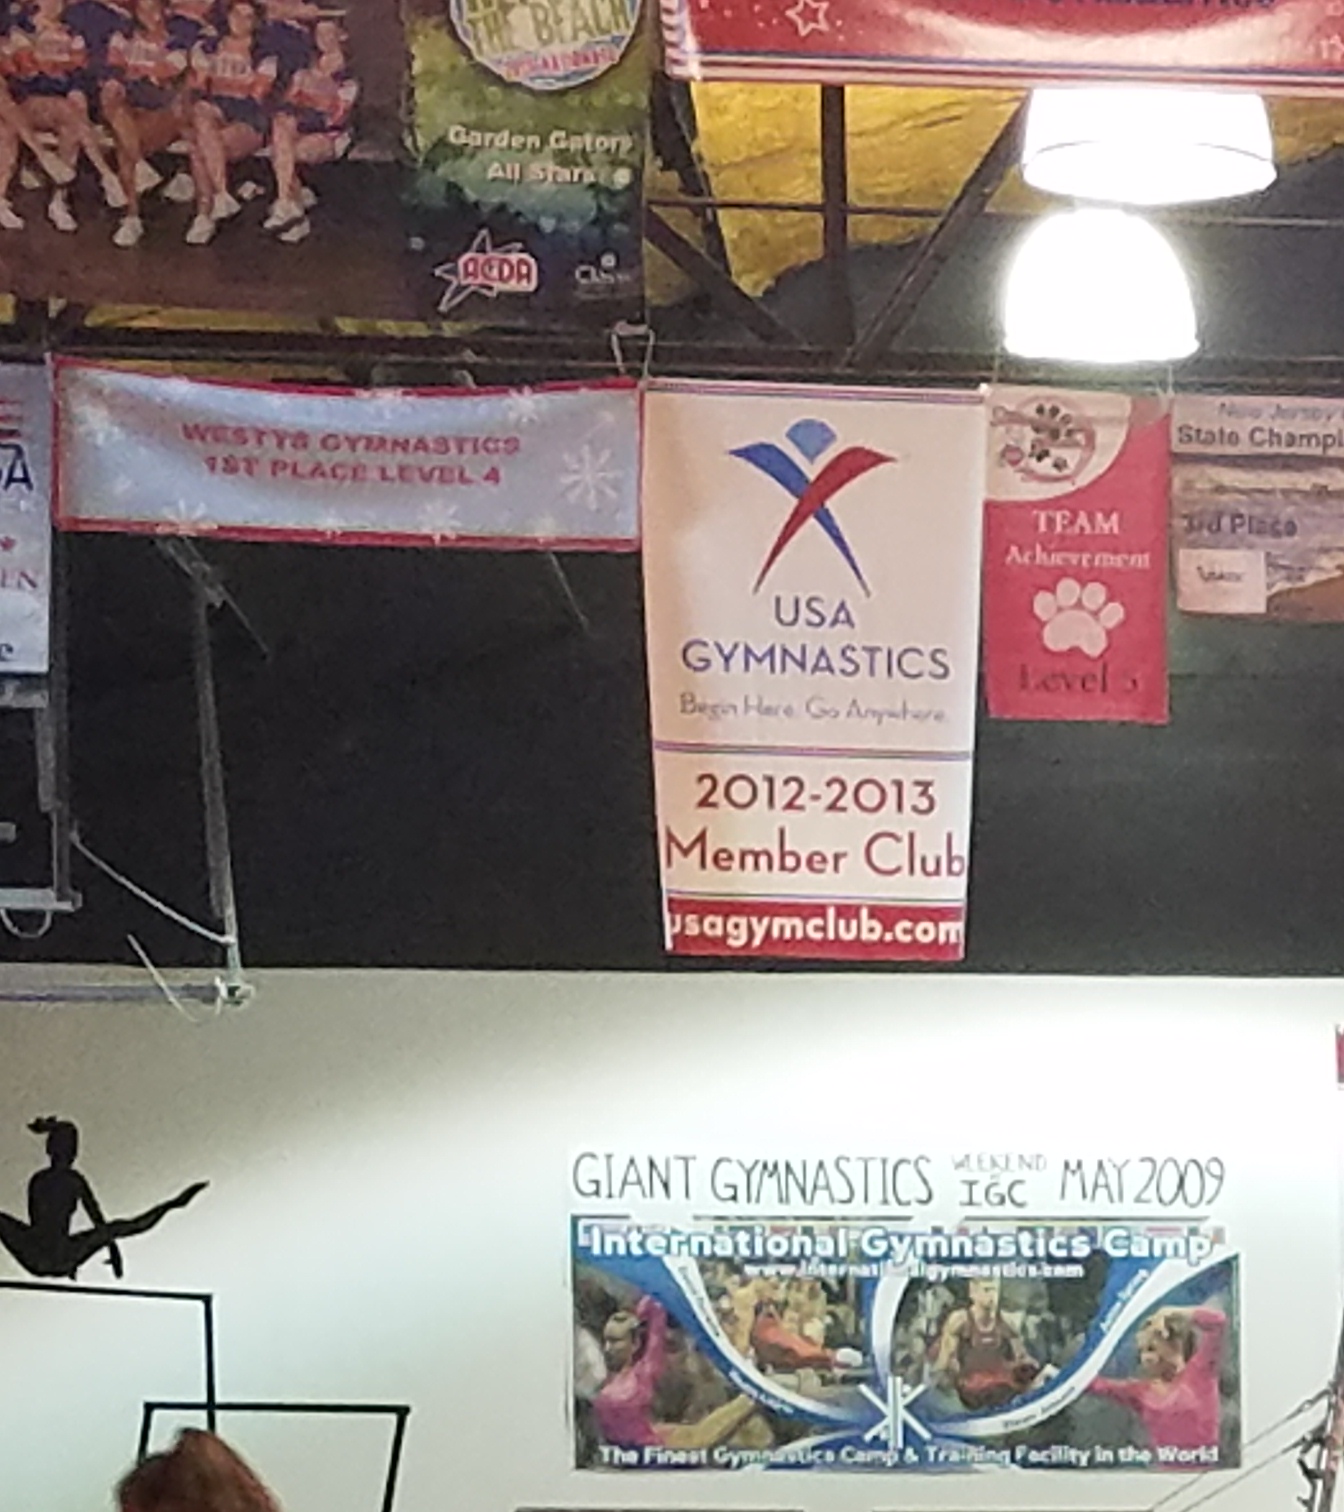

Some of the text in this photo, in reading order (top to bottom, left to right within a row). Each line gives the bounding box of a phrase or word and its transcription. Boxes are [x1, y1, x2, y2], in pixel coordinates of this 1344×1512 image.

[450, 125, 632, 152] Garden Gators
[487, 162, 596, 183] All Stars
[182, 422, 522, 457] WESTYS GYMNASTICS
[1177, 424, 1241, 446] State
[204, 455, 502, 486] 1ST PLACE LEVEL 4
[1033, 509, 1121, 536] TEAM
[1229, 514, 1299, 538] Place
[1006, 543, 1151, 569] Achievement
[775, 595, 855, 630] USA
[682, 638, 951, 680] GYMNASTICS
[1018, 662, 1109, 694] Level
[679, 693, 738, 721] Begin
[805, 697, 839, 719] Go
[696, 773, 937, 816] 2012-2013
[665, 825, 966, 878] Member Club
[950, 1153, 1047, 1173] WEEKEND
[572, 1151, 1226, 1208] GIANT GYMNASTICS IGC MAY 2009
[592, 1226, 1213, 1267] International Gymnastics Camp
[599, 1446, 1219, 1469] The Finest Gymnastics Camp & Training Facility in the World
